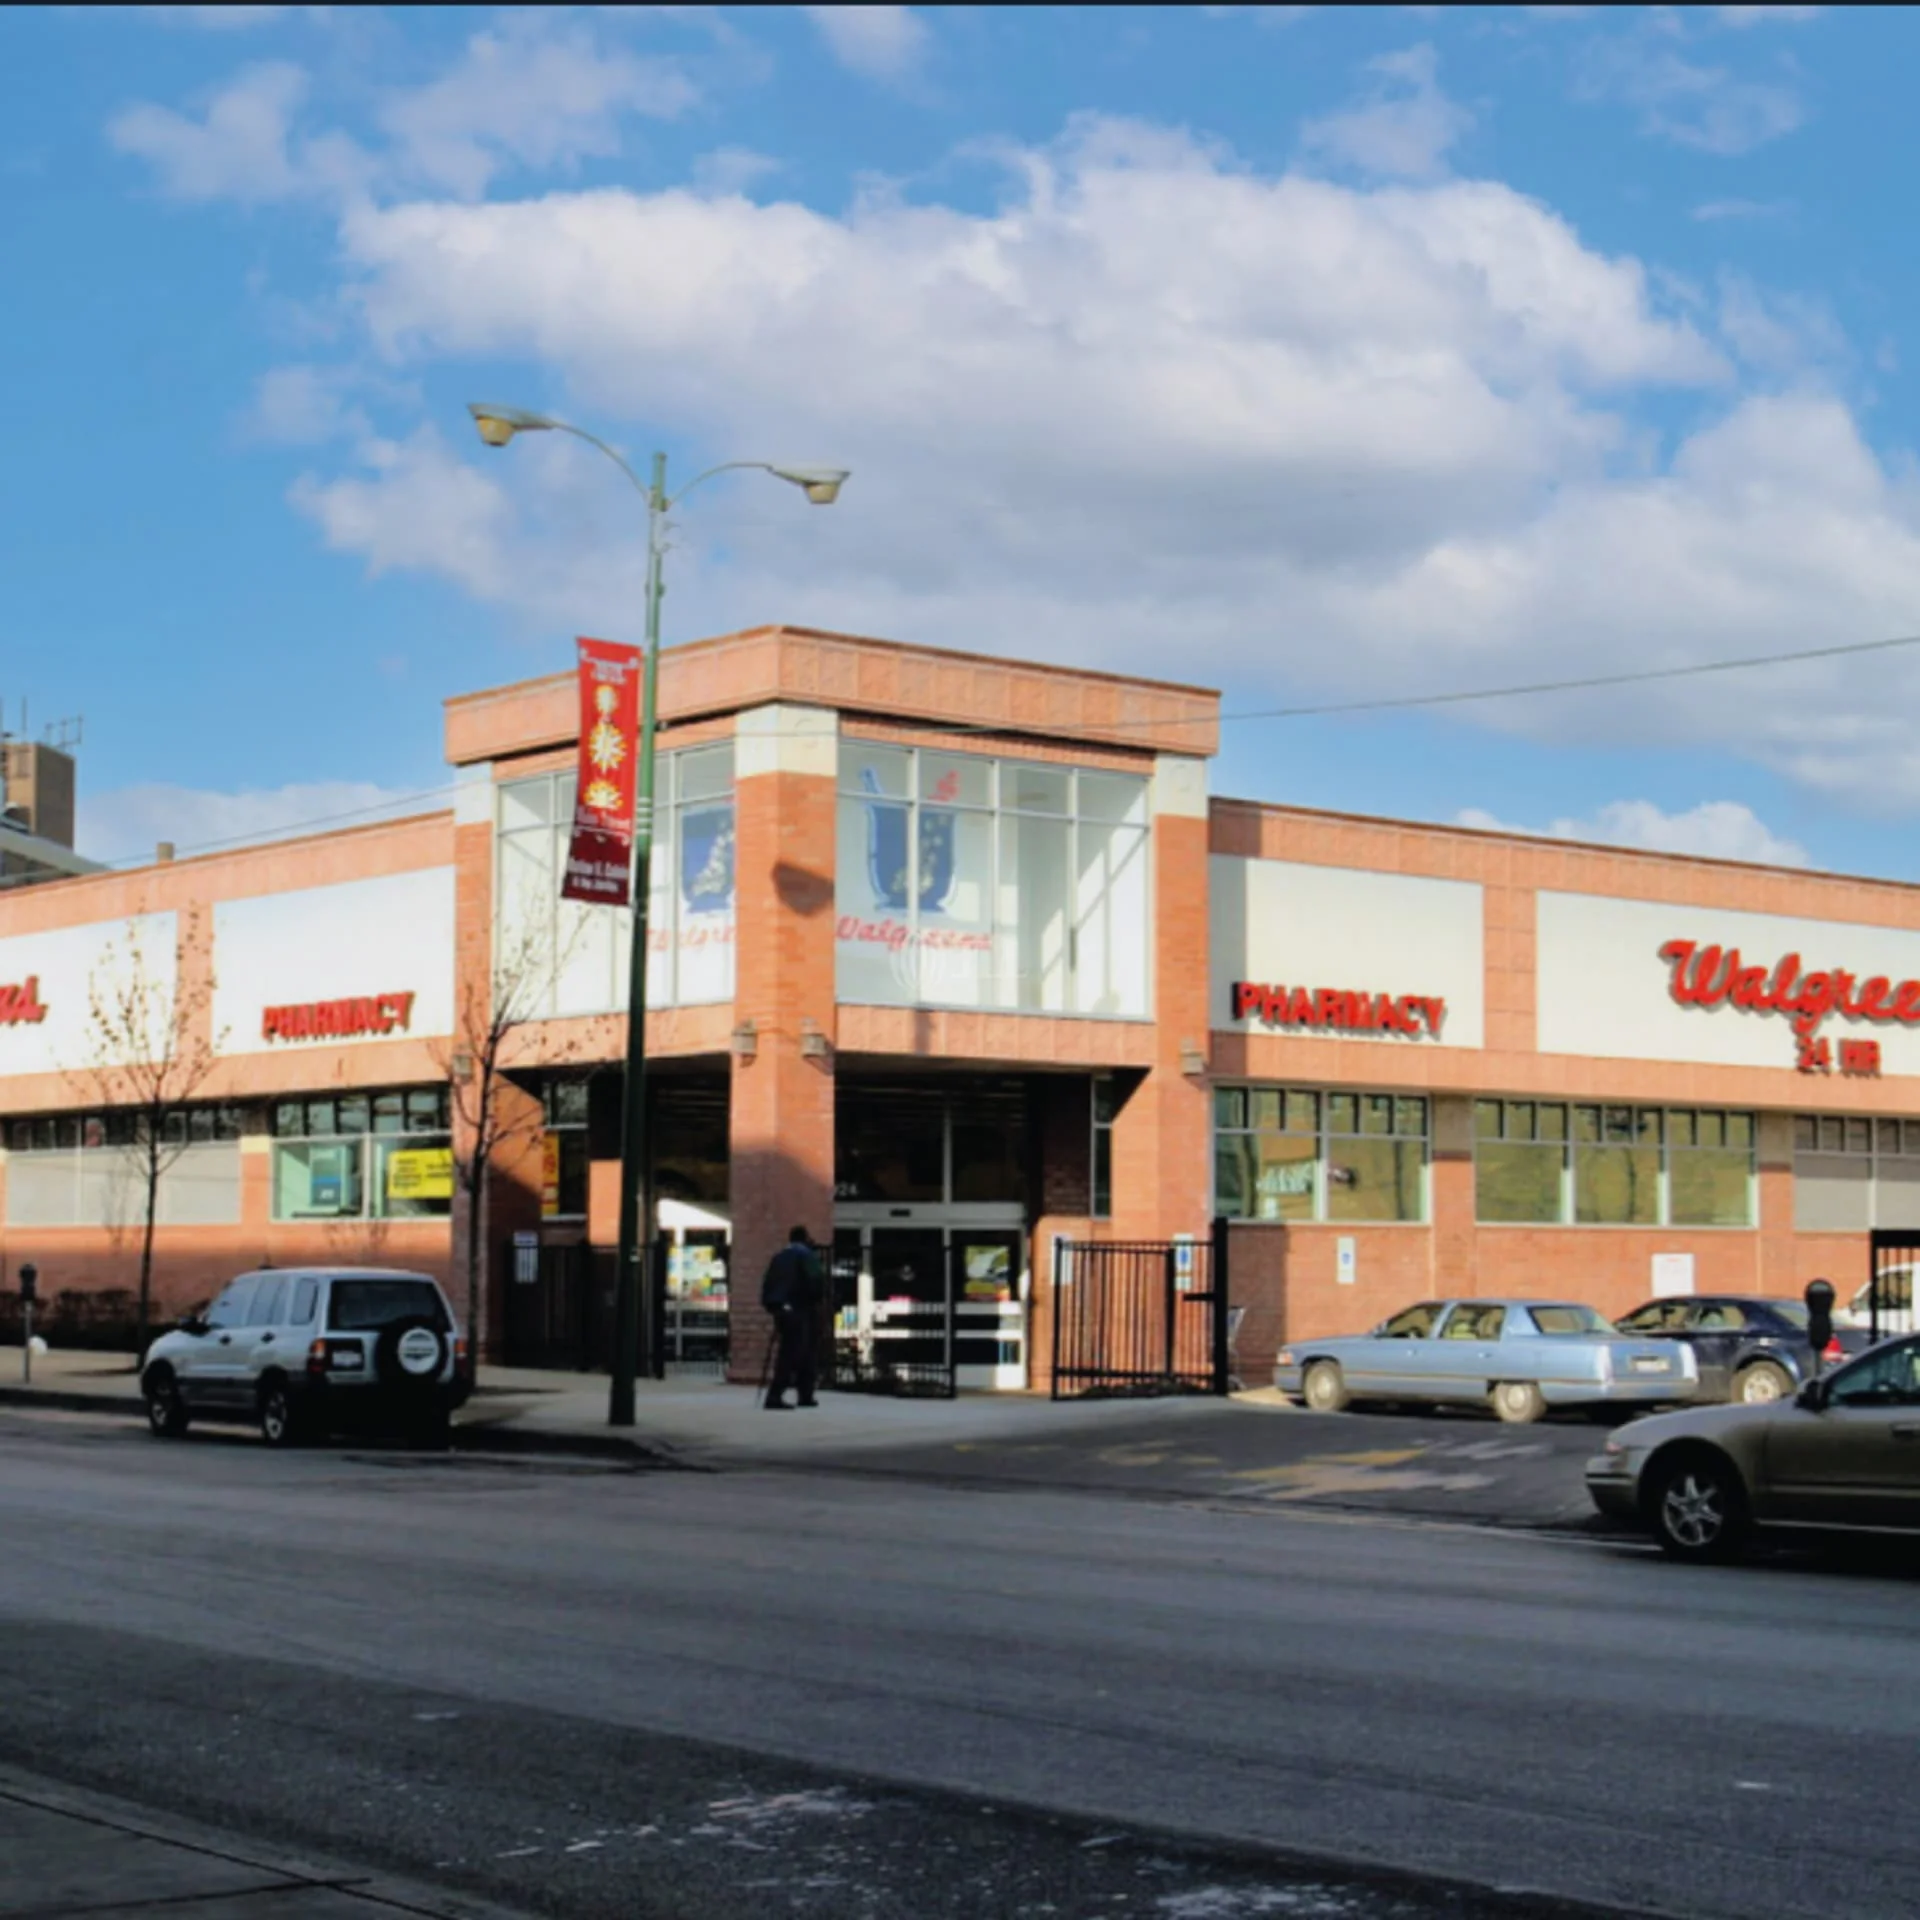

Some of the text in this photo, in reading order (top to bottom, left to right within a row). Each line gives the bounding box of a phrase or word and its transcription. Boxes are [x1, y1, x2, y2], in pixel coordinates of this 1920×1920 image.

[262, 990, 415, 1041] PHARMACY
[1233, 981, 1446, 1035] PHARMACY
[1796, 1036, 1831, 1073] 24
